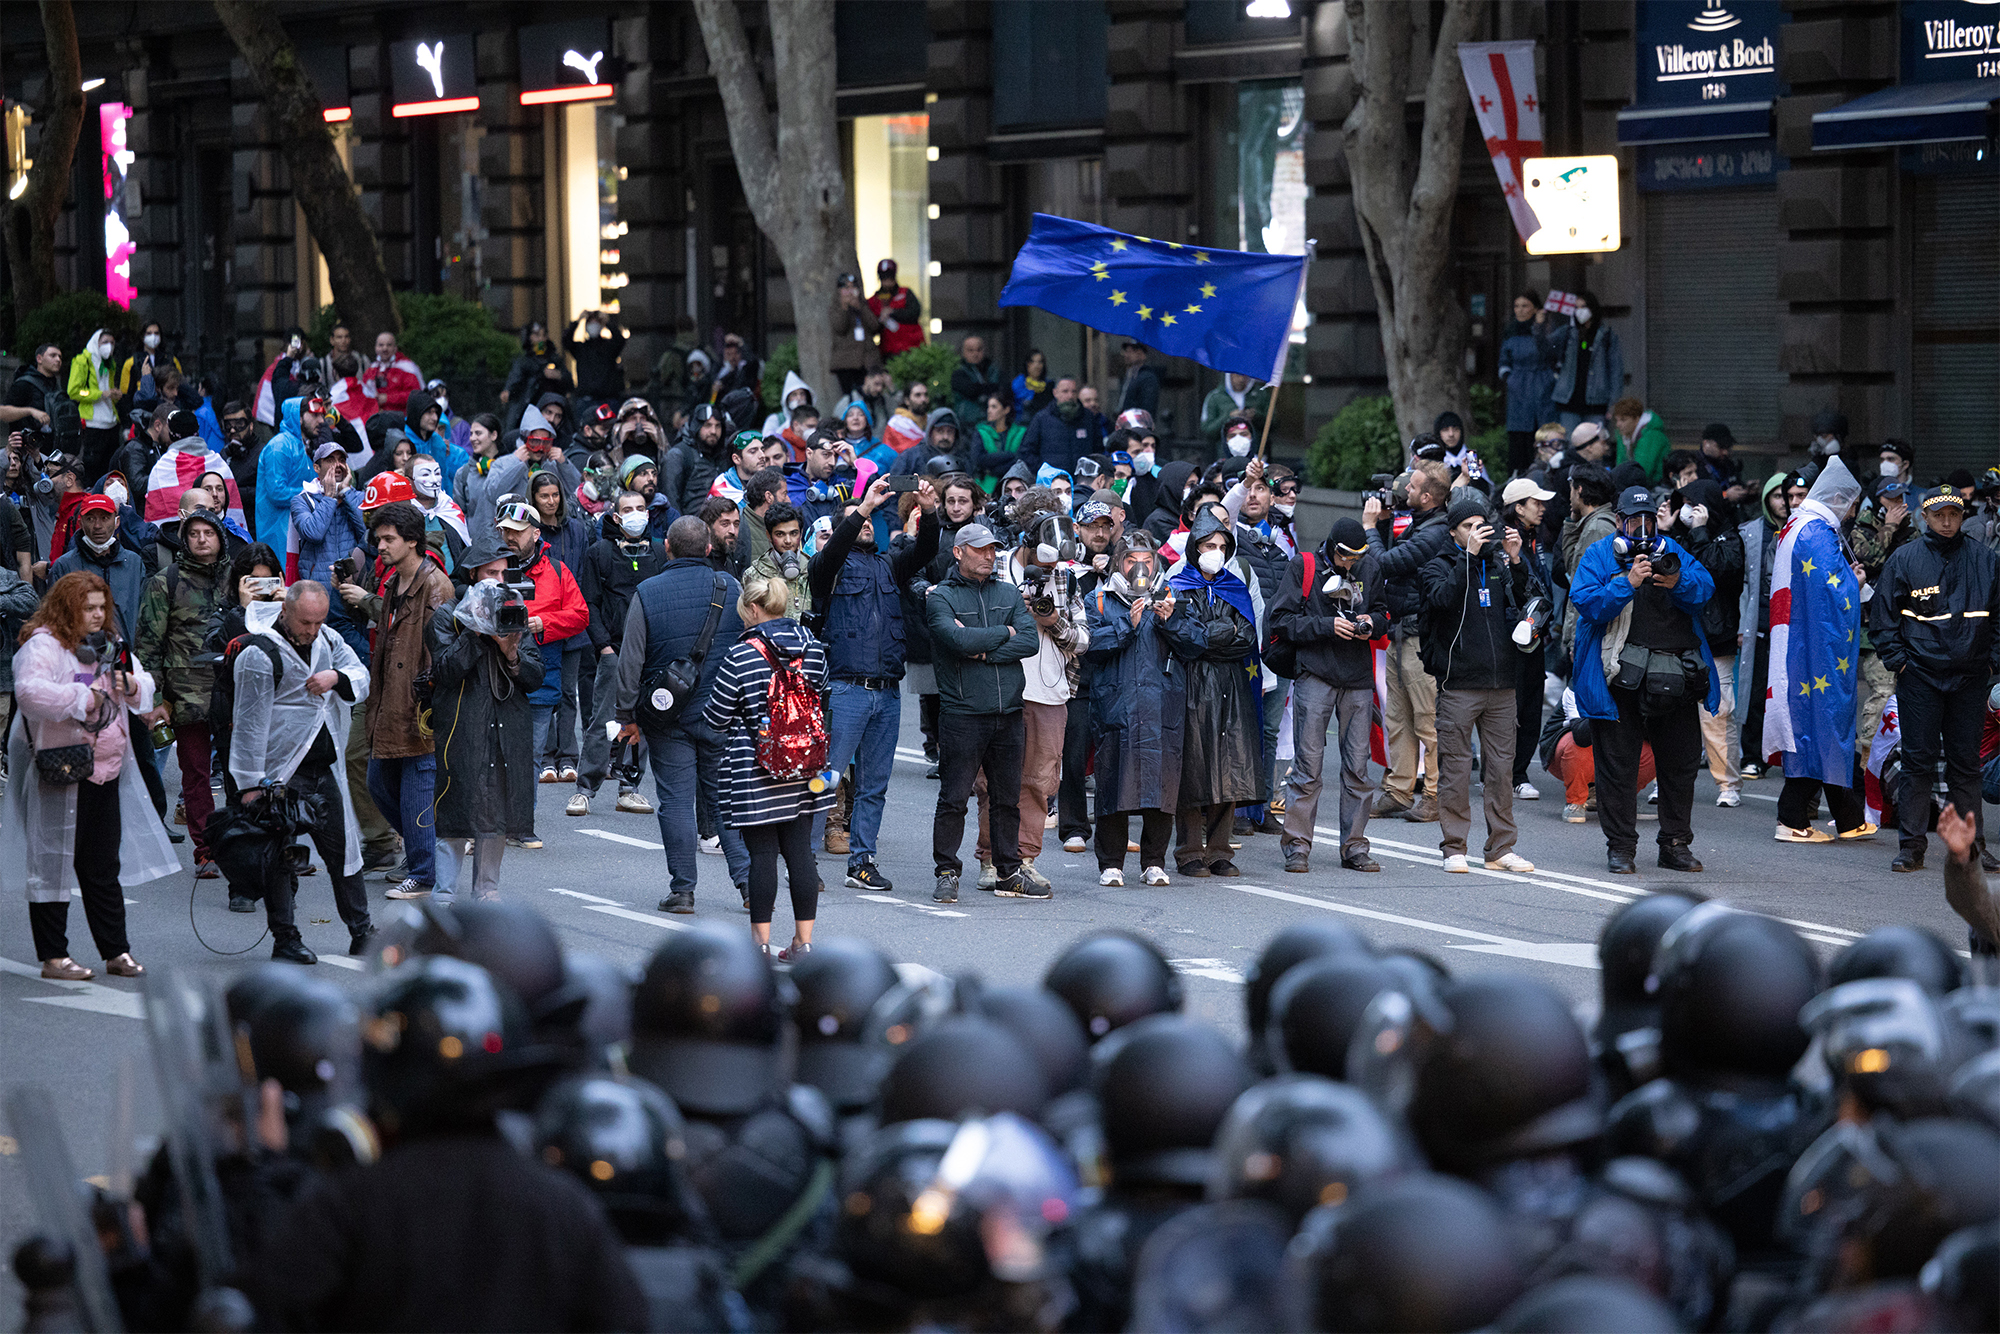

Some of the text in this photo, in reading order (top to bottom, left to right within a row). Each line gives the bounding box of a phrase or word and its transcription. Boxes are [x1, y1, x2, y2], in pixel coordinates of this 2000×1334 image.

[1924, 18, 1994, 54] Villeroy
[1655, 36, 1774, 77] Villeroy & Boch
